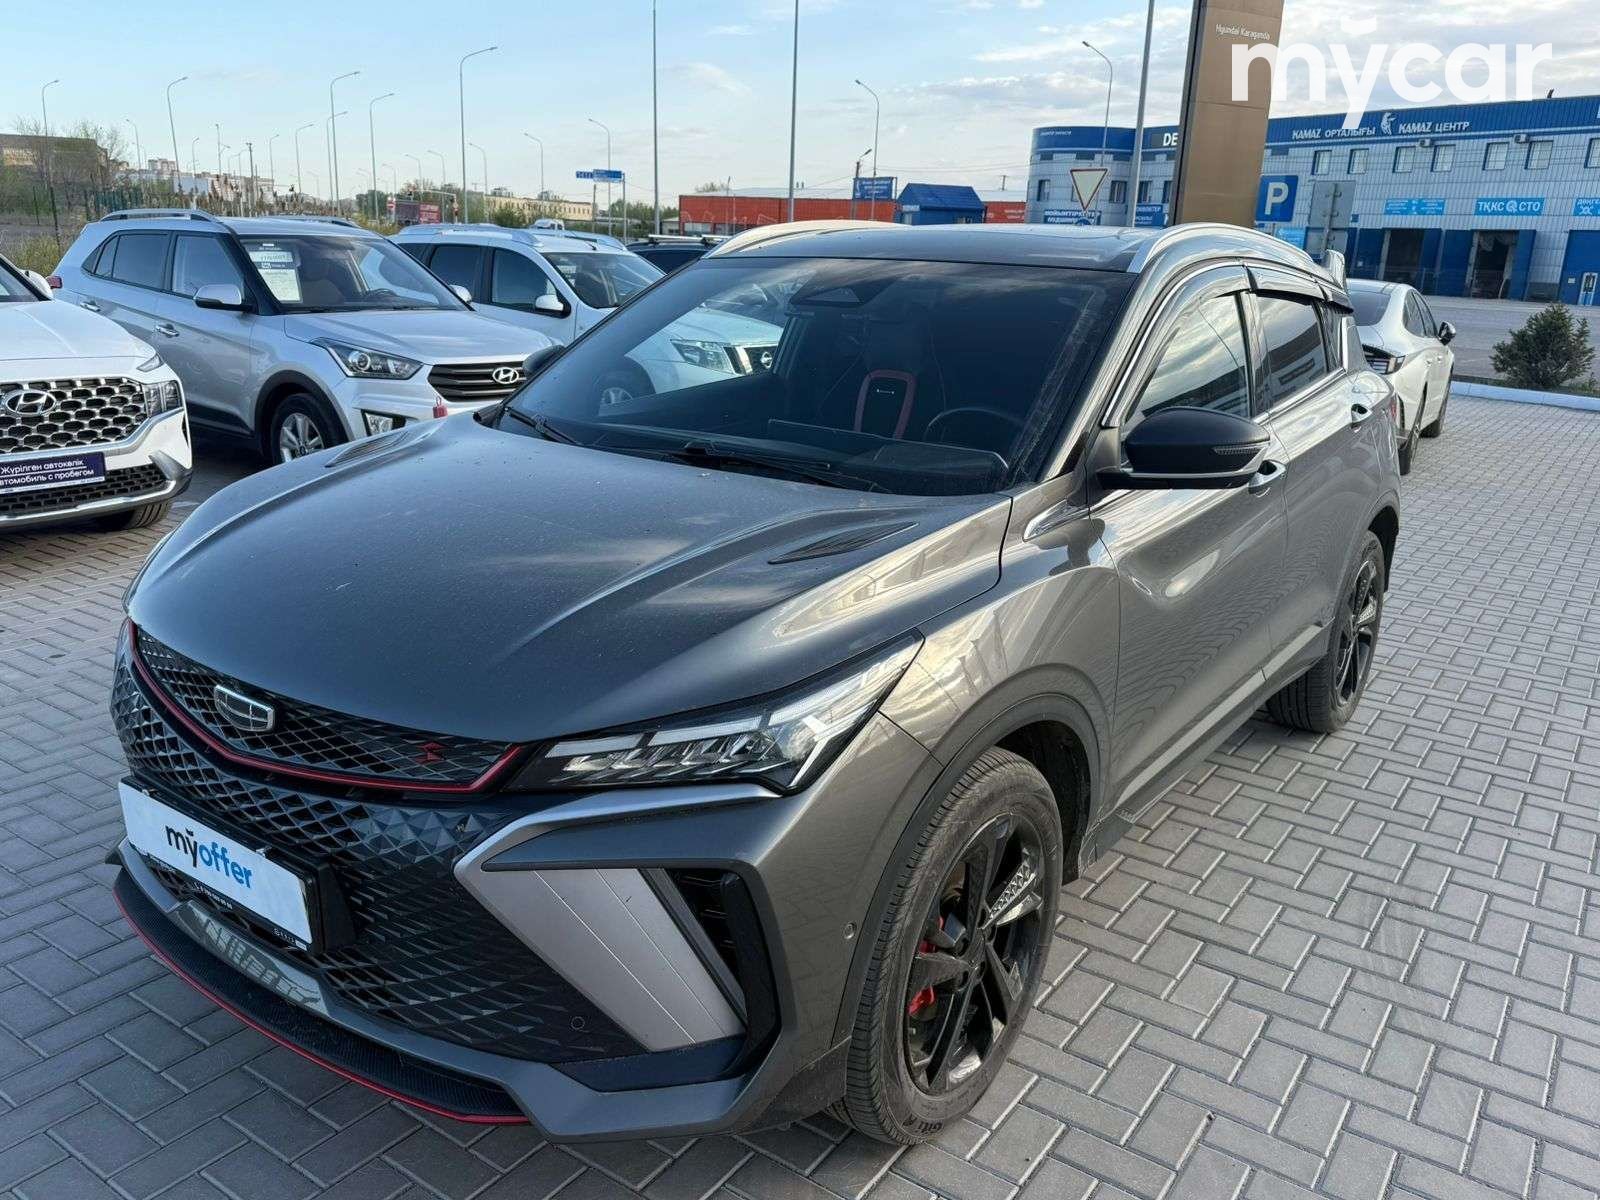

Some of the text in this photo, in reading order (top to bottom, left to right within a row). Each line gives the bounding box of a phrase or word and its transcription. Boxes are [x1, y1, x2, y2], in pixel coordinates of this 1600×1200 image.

[1435, 121, 1470, 132] ЦЕНТР
[1265, 182, 1289, 215] P
[1519, 201, 1541, 211] СТО
[54, 469, 94, 480] пробегом
